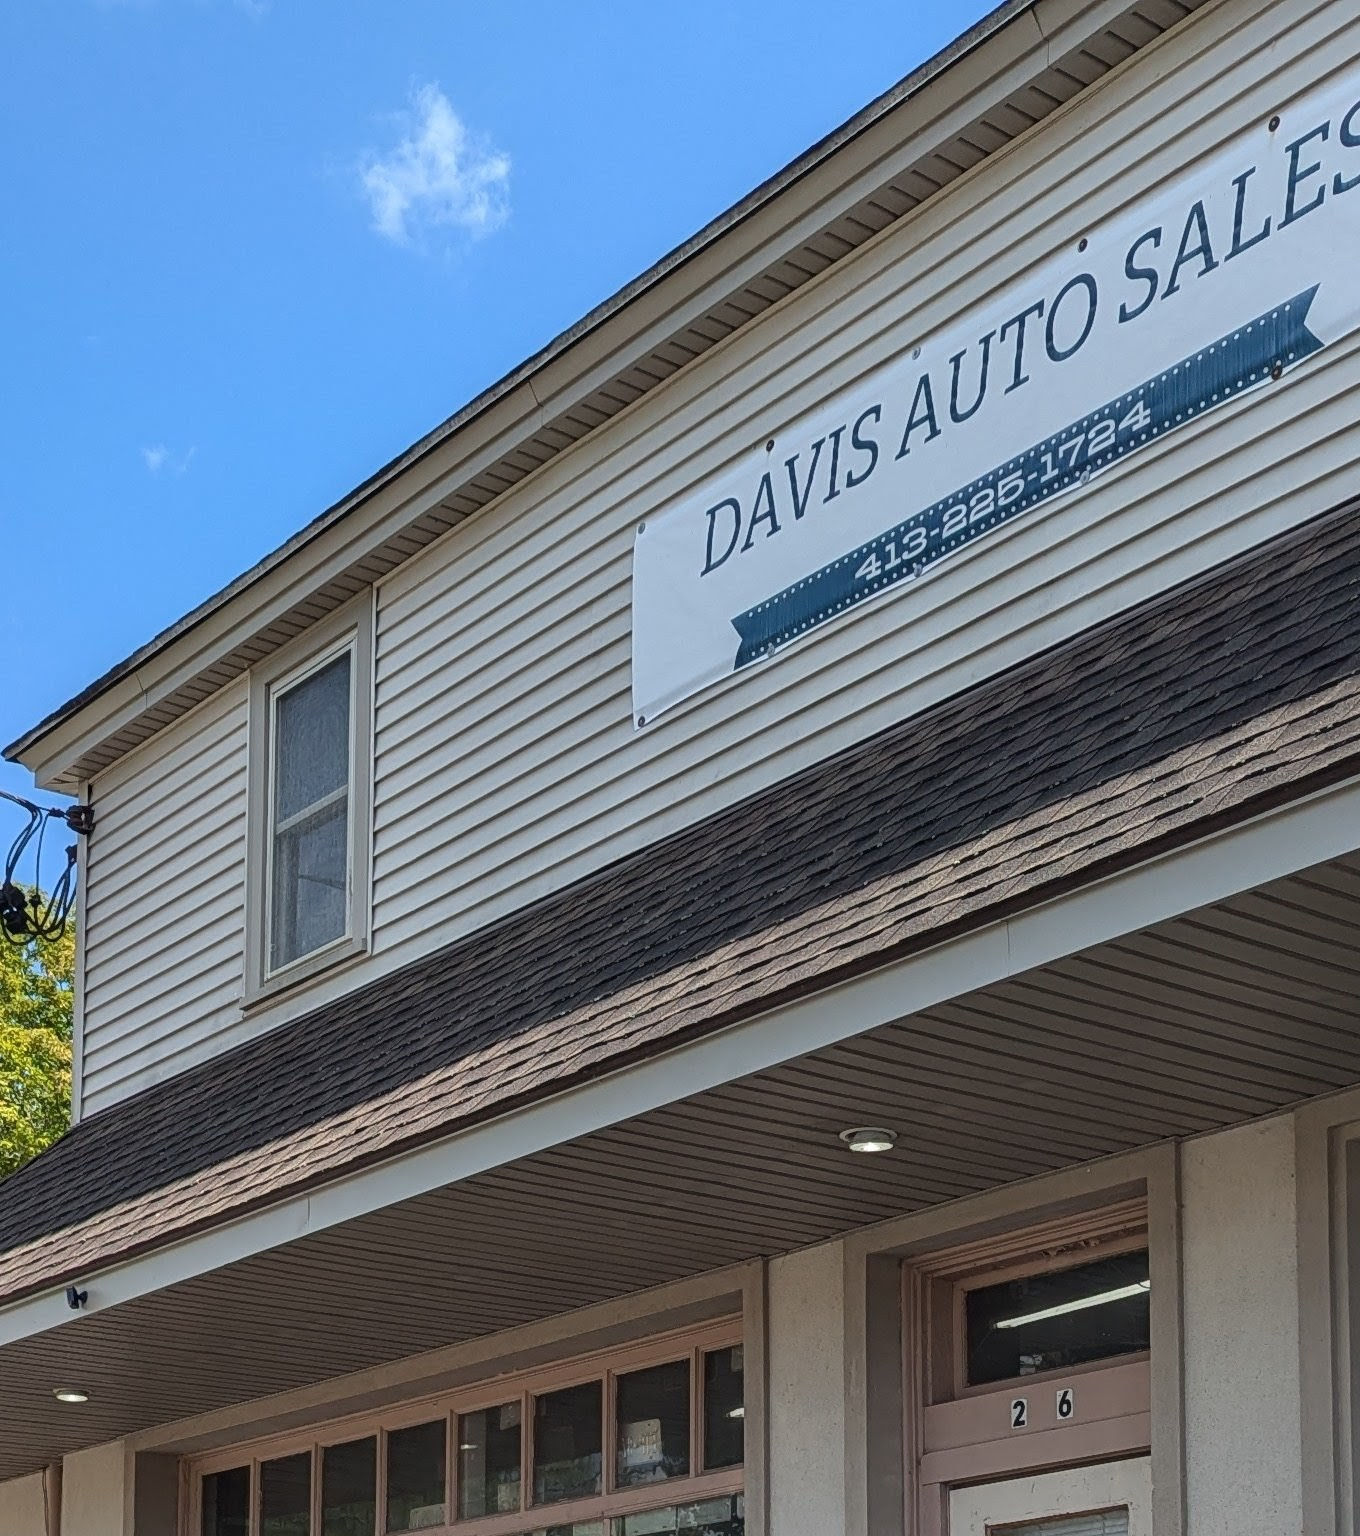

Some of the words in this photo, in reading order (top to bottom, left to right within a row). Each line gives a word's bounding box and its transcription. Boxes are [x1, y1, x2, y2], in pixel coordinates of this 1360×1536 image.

[700, 404, 882, 578] DAVIS
[895, 273, 1098, 461] AUTO
[854, 400, 1152, 582] 413-225-1724
